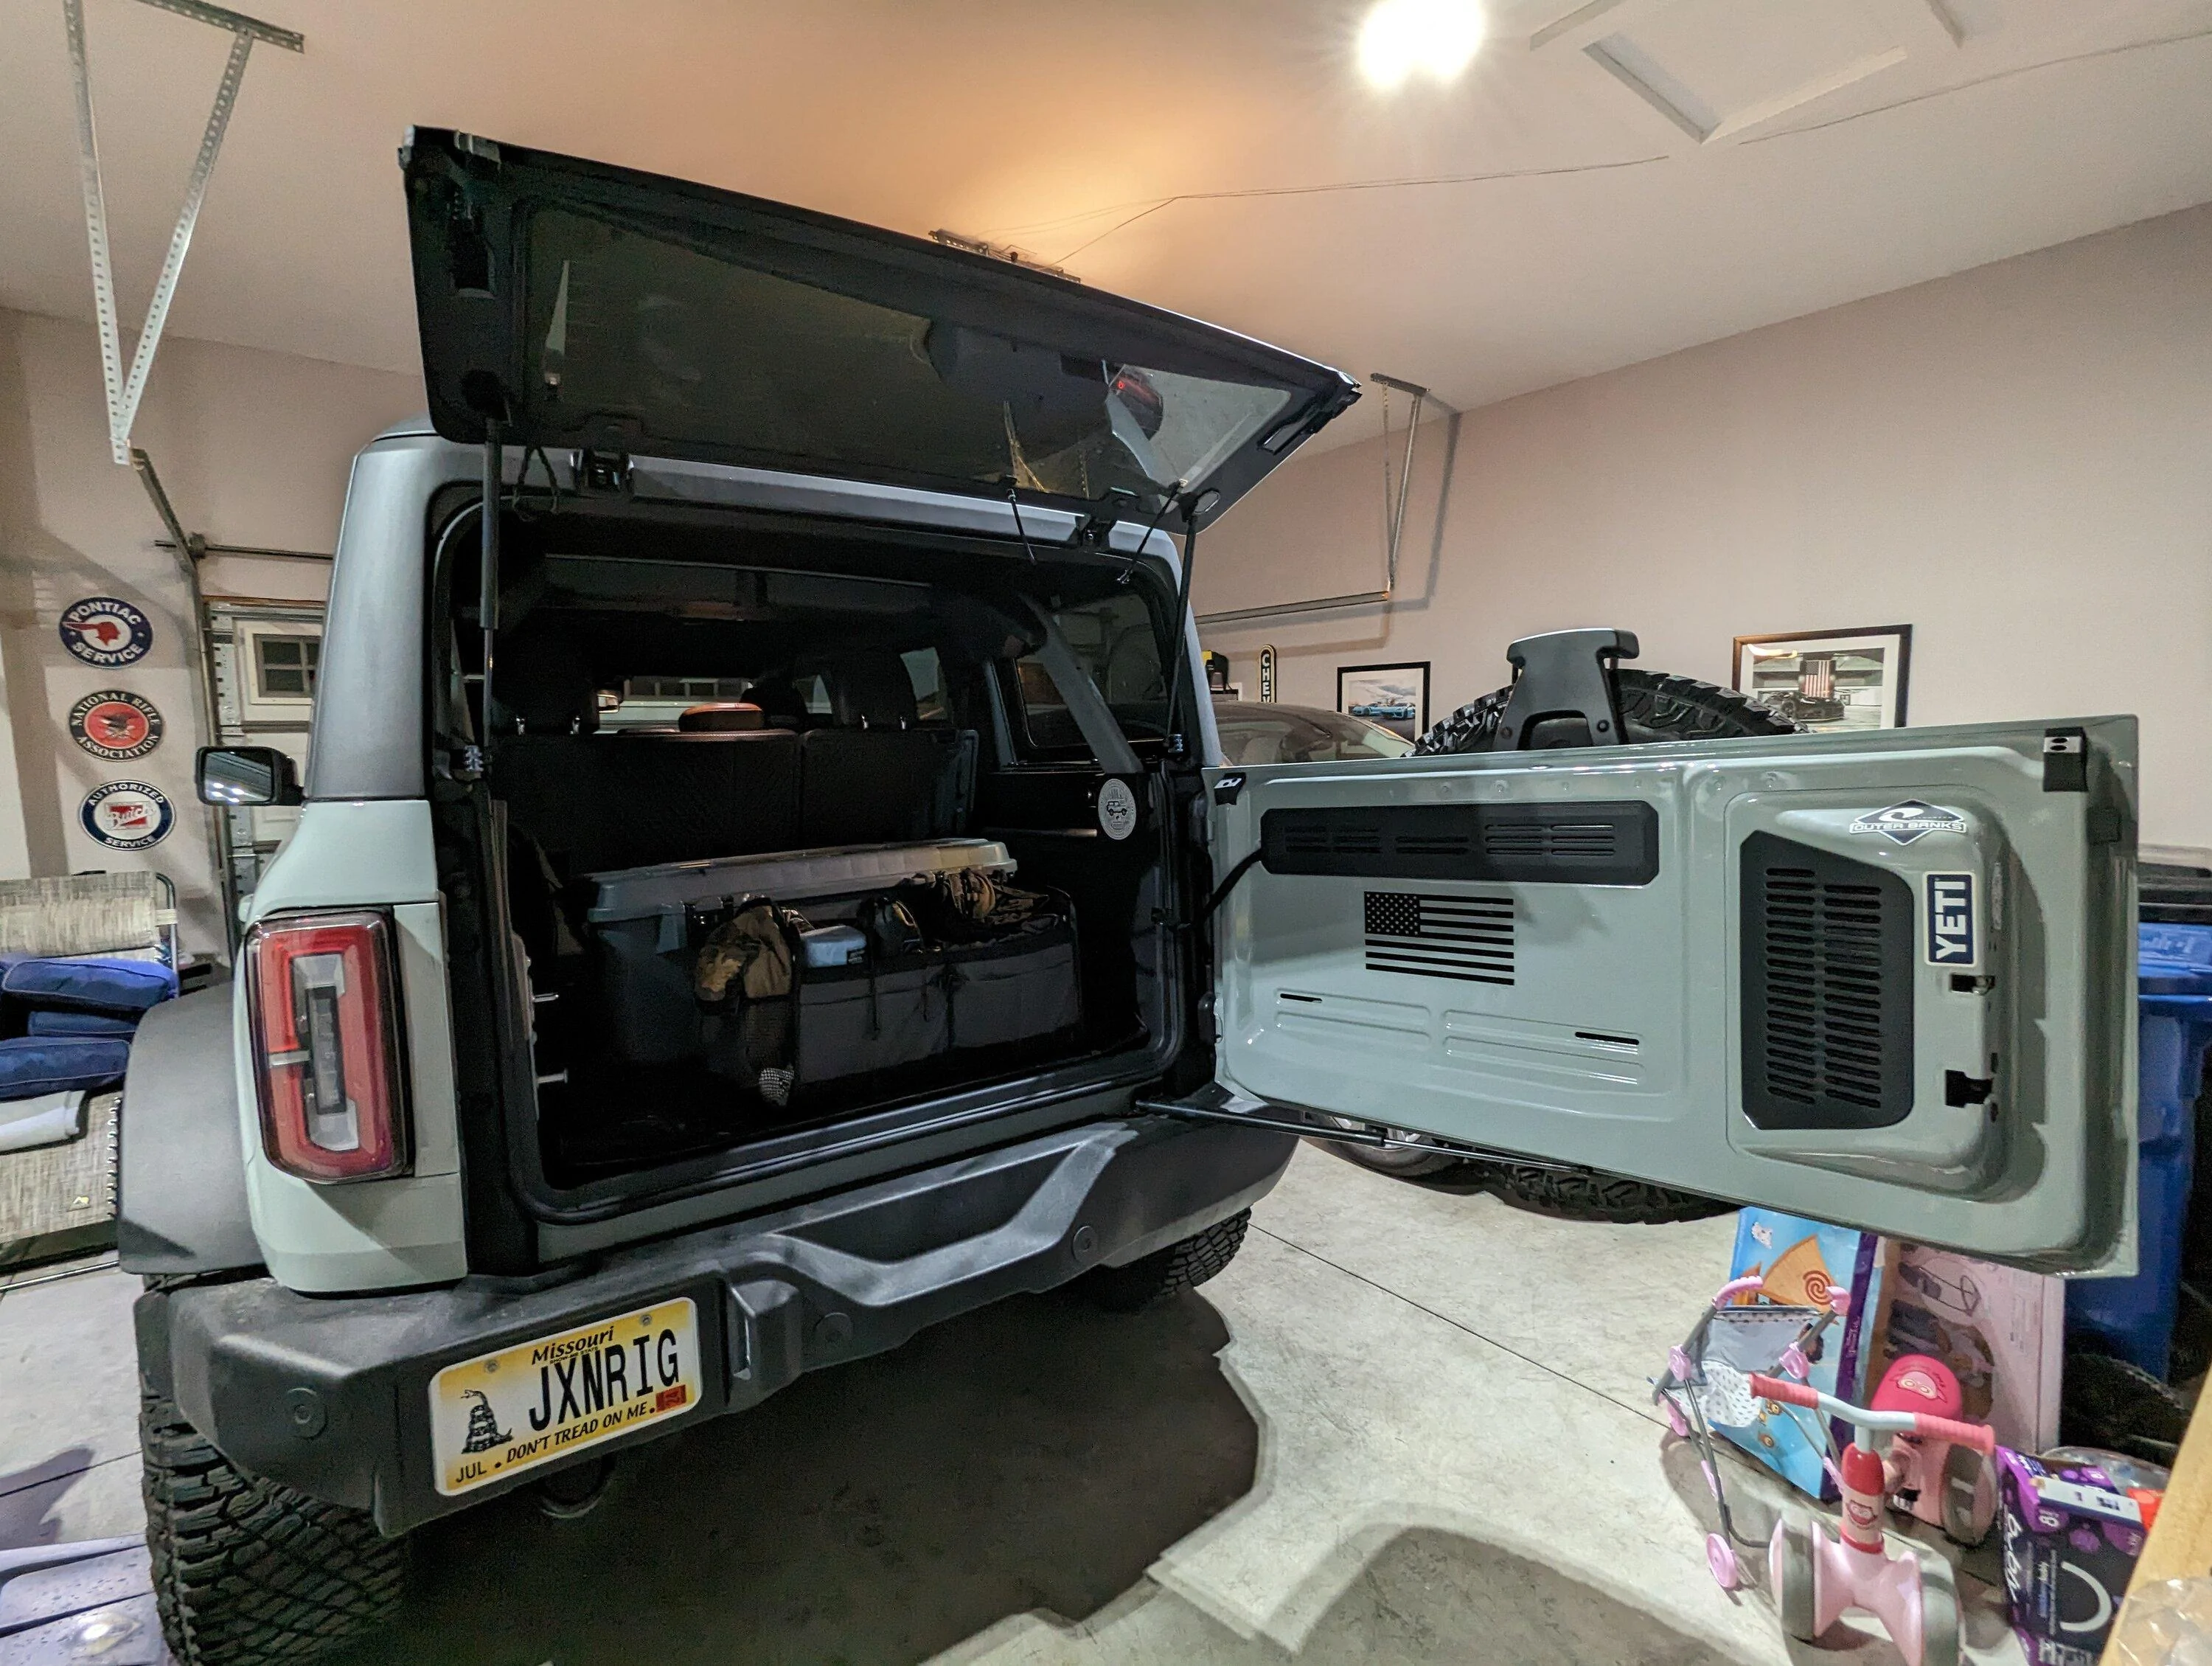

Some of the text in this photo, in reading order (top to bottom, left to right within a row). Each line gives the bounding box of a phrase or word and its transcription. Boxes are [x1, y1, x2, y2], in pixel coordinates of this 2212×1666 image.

[70, 601, 142, 625] PONTIAC
[73, 642, 144, 664] SERVICE
[72, 692, 162, 726] NATIONAL RIFLE
[76, 733, 159, 759] ASSOCIATION
[87, 782, 164, 807] AUTHORIZED
[1854, 822, 1963, 831] OUTER BANKS
[104, 836, 156, 849] SERVICE
[1934, 881, 1966, 959] YETI
[532, 1326, 614, 1365] Missouri
[529, 1328, 680, 1431] JXNRIG
[507, 1434, 549, 1463] DON'T
[554, 1418, 598, 1446] TREAD
[602, 1410, 622, 1429] ON
[455, 1461, 487, 1483] JUL
